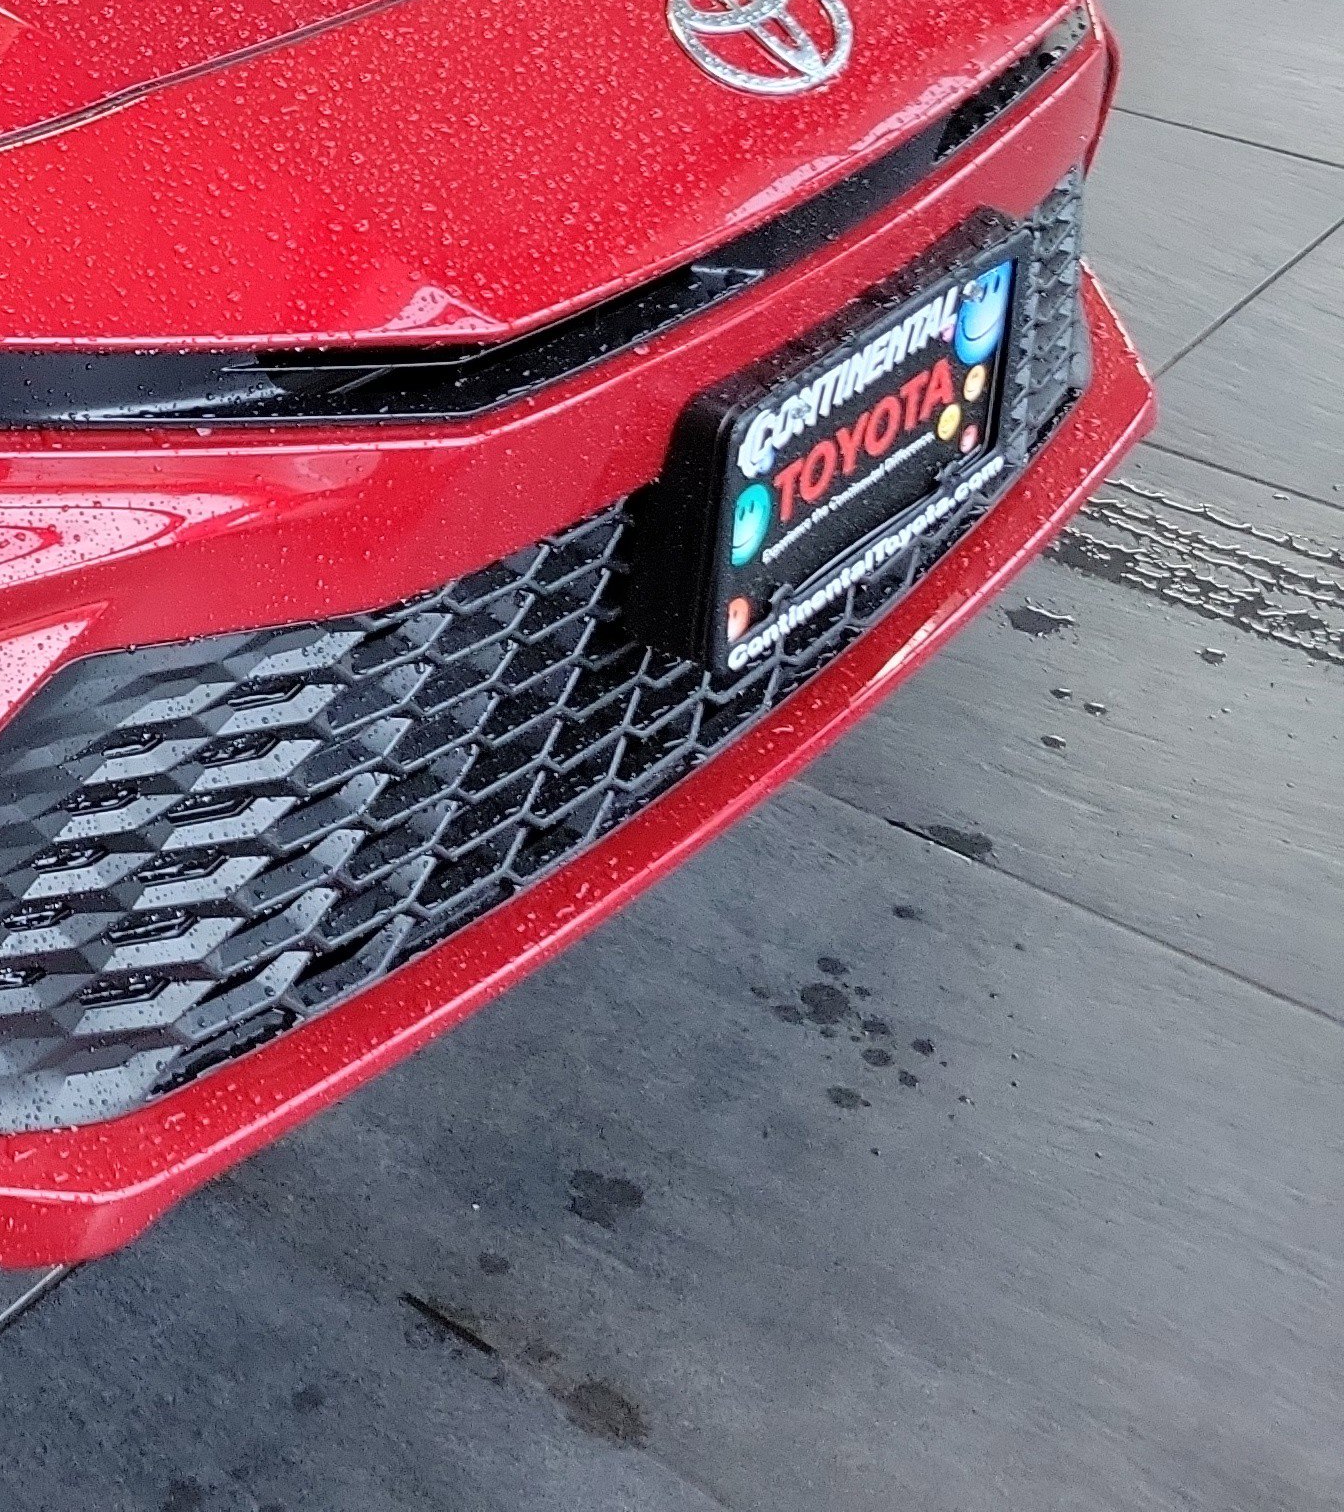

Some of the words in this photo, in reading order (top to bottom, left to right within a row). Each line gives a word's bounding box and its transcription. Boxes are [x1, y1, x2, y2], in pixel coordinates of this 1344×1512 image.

[739, 285, 959, 478] CONTINENTAL
[772, 356, 955, 523] TOYOTA
[727, 455, 1005, 671] ContinentalToyota.com
